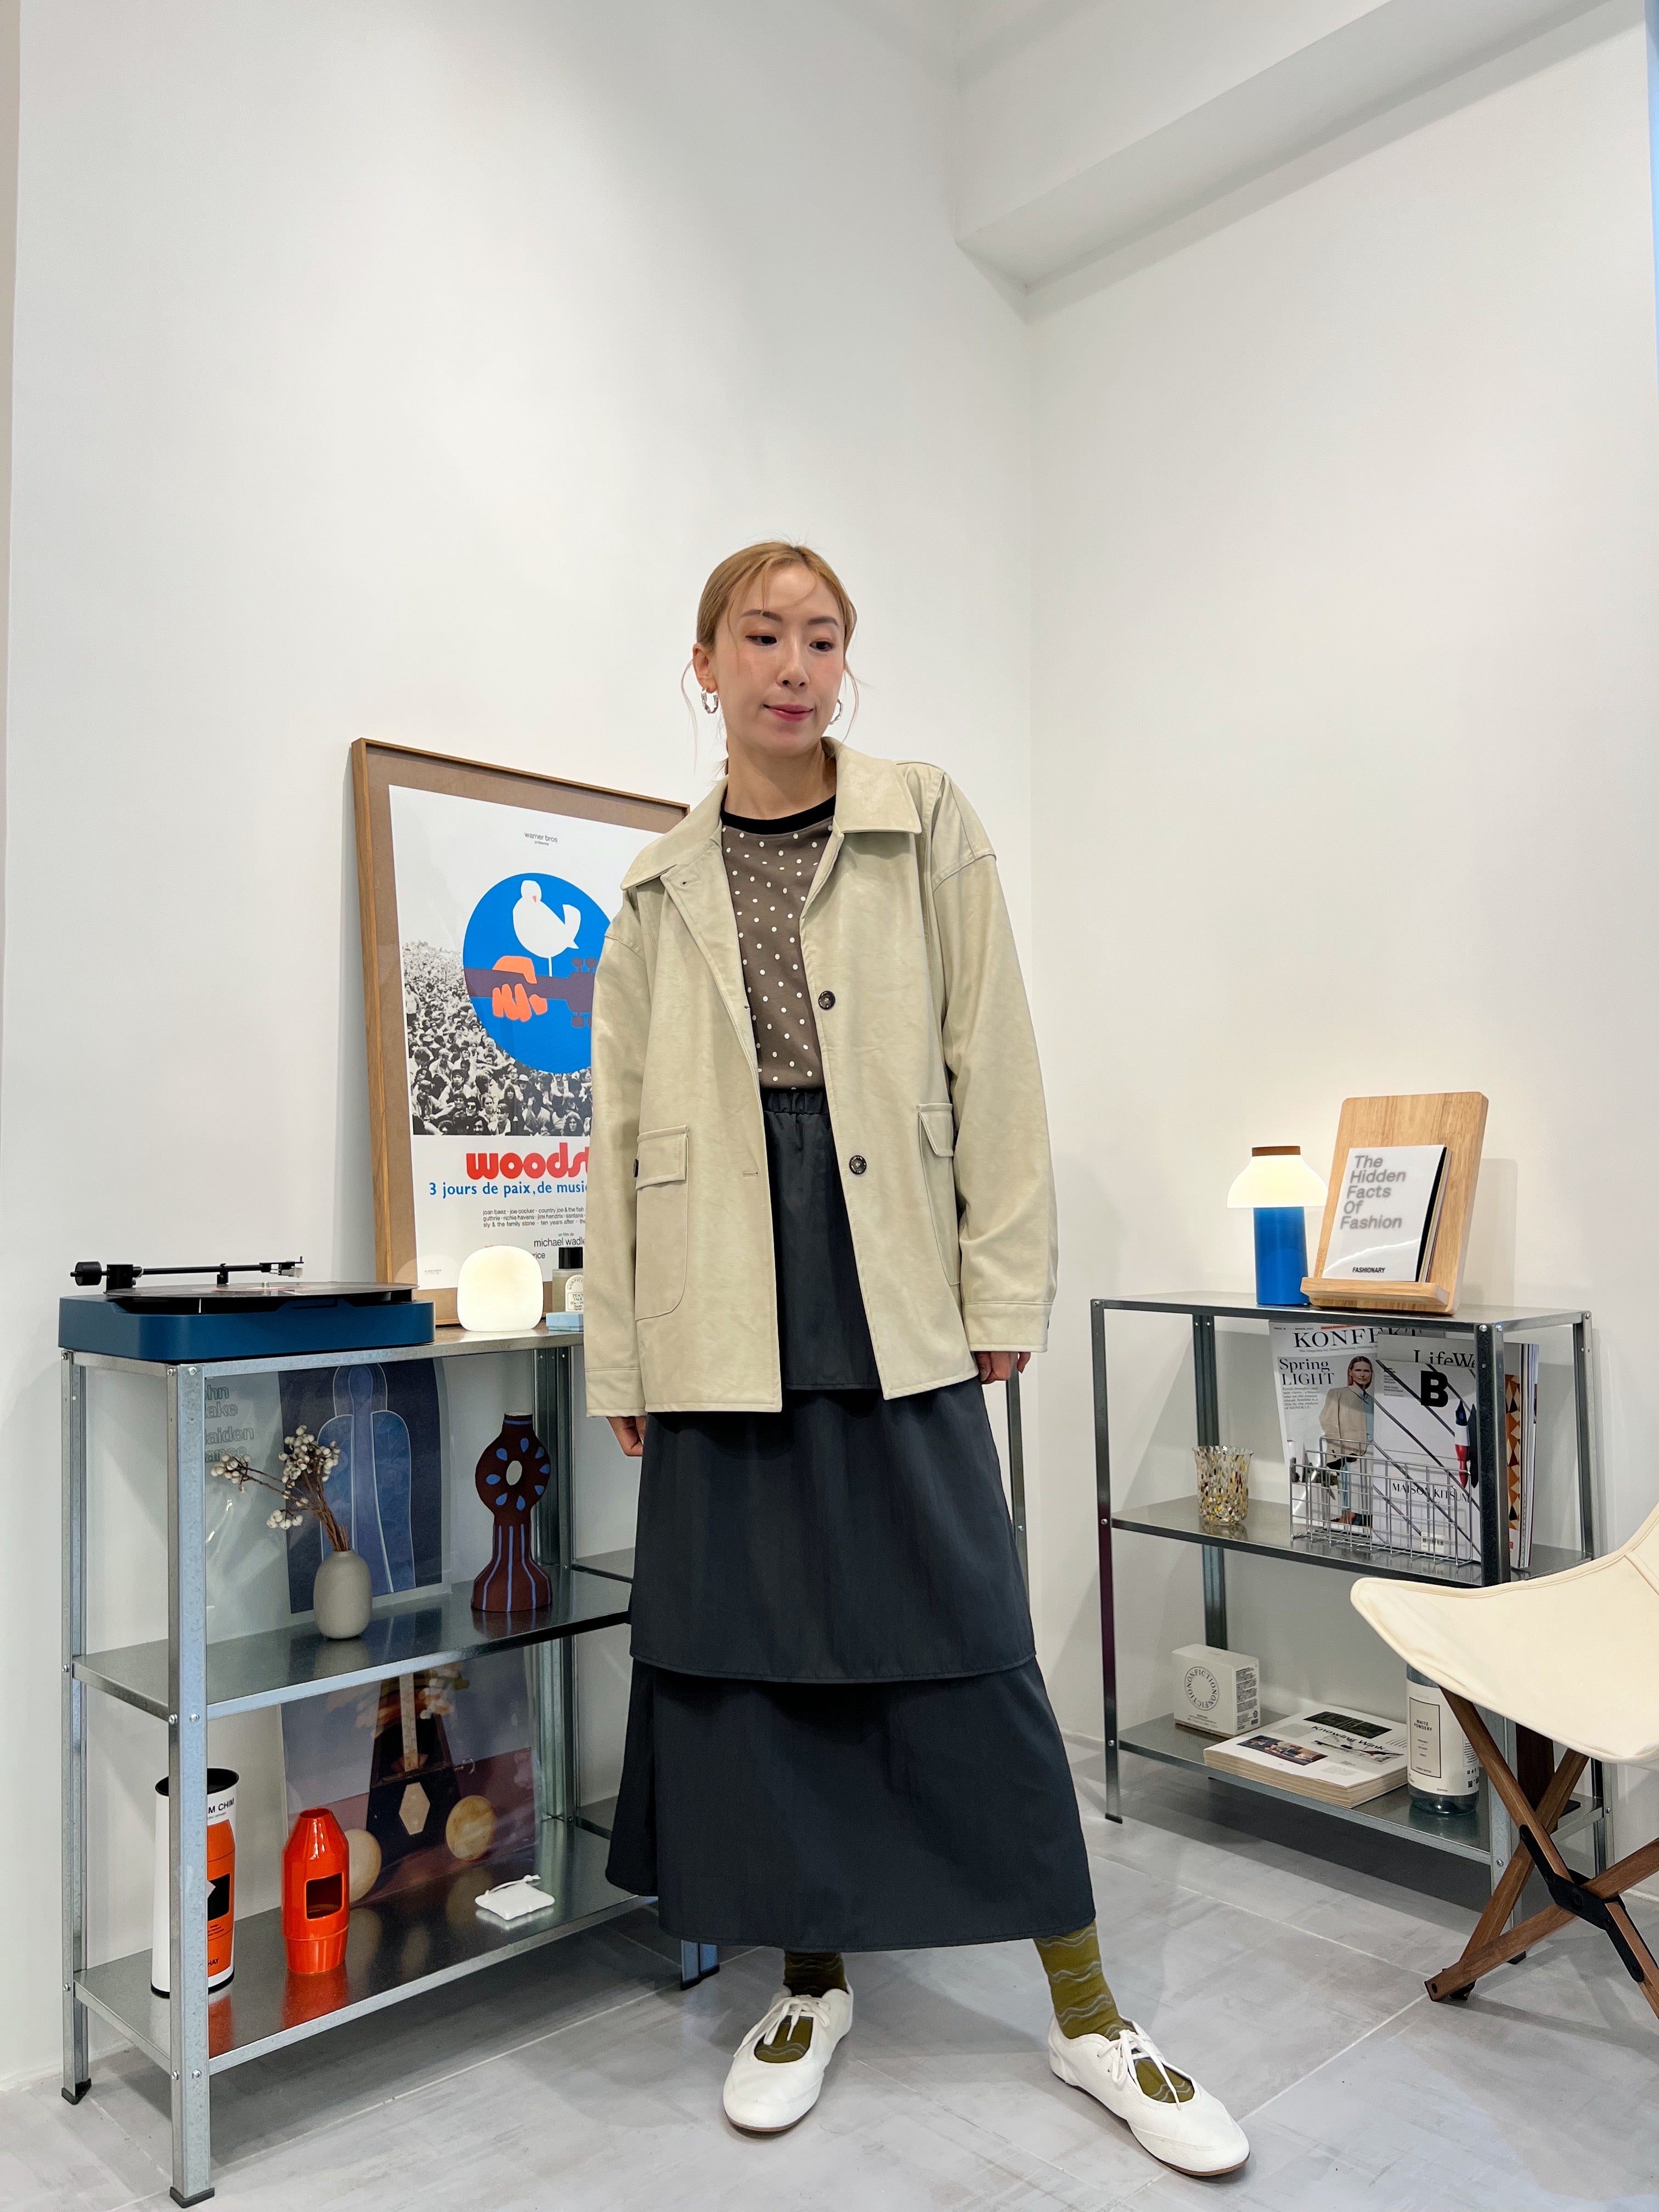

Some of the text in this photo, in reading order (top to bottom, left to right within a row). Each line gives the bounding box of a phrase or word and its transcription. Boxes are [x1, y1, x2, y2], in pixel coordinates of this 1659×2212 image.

[545, 834, 558, 843] bros
[1355, 1155, 1383, 1168] The
[1350, 1169, 1407, 1183] Hidden
[429, 1182, 437, 1195] 3
[443, 1182, 477, 1199] jours
[482, 1182, 498, 1194] de
[537, 1181, 552, 1193] de
[557, 1181, 588, 1193] musi
[1346, 1185, 1392, 1199] Facts
[1343, 1200, 1364, 1215] Of
[1340, 1214, 1402, 1230] Fashion
[534, 1238, 563, 1247] michael
[1279, 1358, 1330, 1373] Spring
[1282, 1373, 1335, 1385] LIGHT
[1421, 1370, 1448, 1408] B
[205, 1402, 238, 1419] ake
[205, 1426, 254, 1445] aiden
[1311, 1726, 1357, 1742] Knowing
[1358, 1740, 1385, 1750] Wink
[218, 1797, 234, 1811] CHIM
[208, 1957, 219, 1966] HAY
